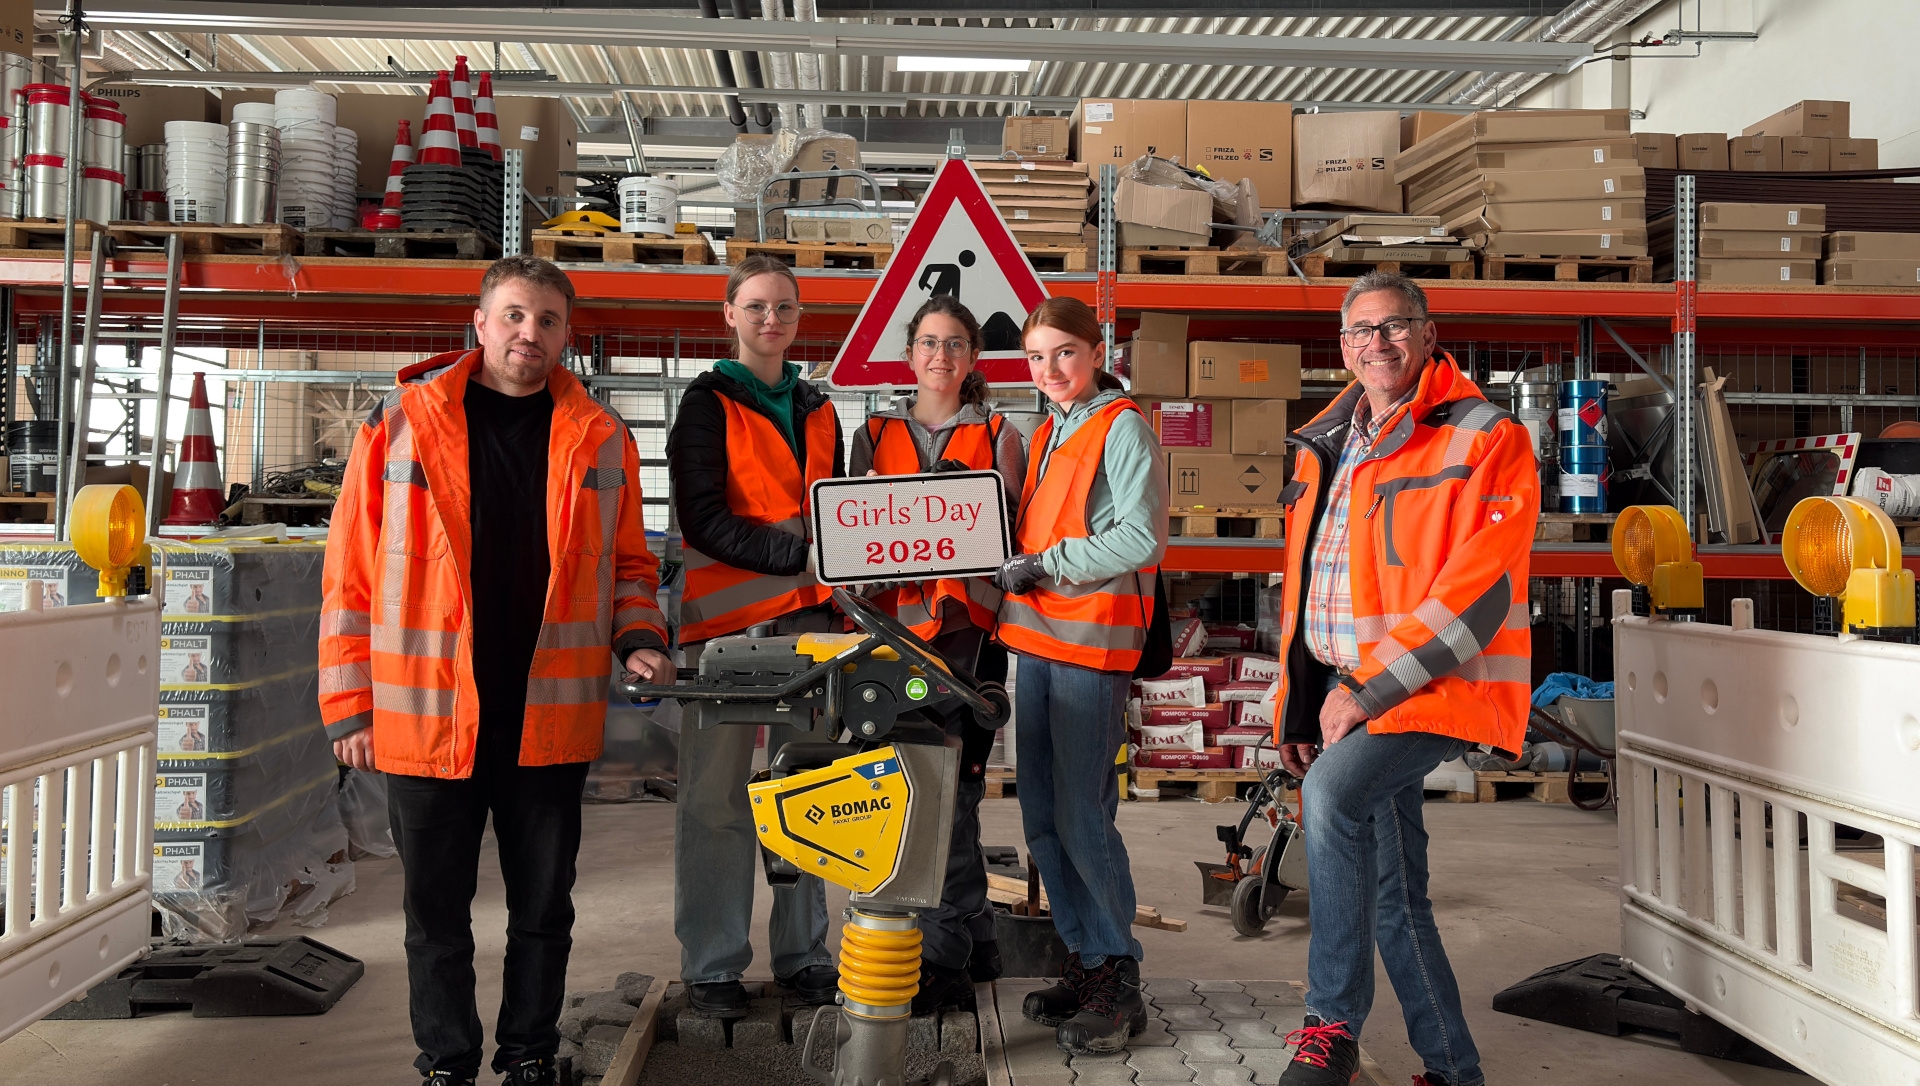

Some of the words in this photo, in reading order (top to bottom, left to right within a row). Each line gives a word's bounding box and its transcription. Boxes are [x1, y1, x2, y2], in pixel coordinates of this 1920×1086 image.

[97, 88, 141, 98] PHILIPS
[1325, 158, 1348, 166] FRIZA
[1325, 165, 1353, 173] PILZEO
[866, 537, 956, 565] 2026
[1146, 690, 1187, 702] ROMEX
[1145, 734, 1186, 745] ROMEX
[830, 796, 892, 818] BOMAG
[832, 817, 851, 825] FAYAT
[851, 814, 872, 822] GROUP
